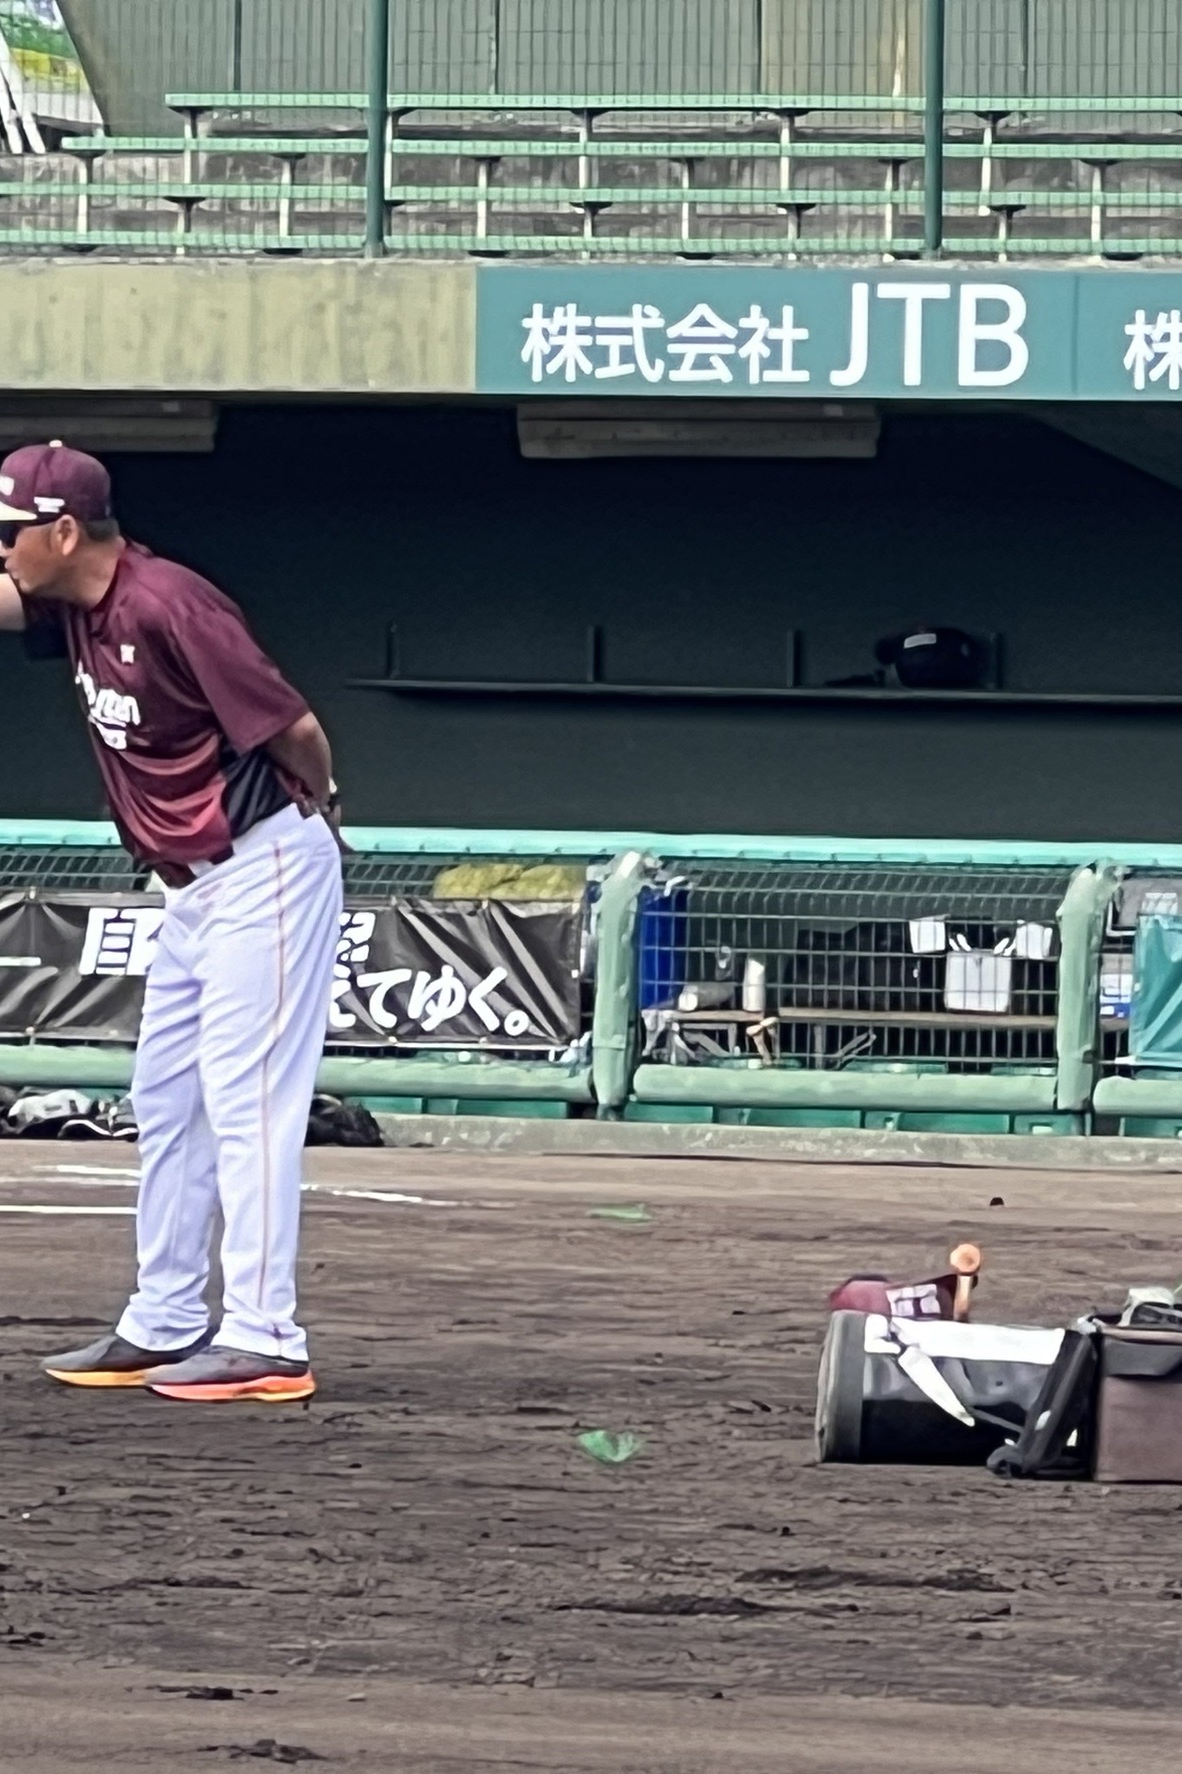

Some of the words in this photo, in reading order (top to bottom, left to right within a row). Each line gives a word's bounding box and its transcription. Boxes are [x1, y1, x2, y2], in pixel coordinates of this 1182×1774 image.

[520, 303, 810, 384] 株式会社
[830, 282, 1029, 387] JTB
